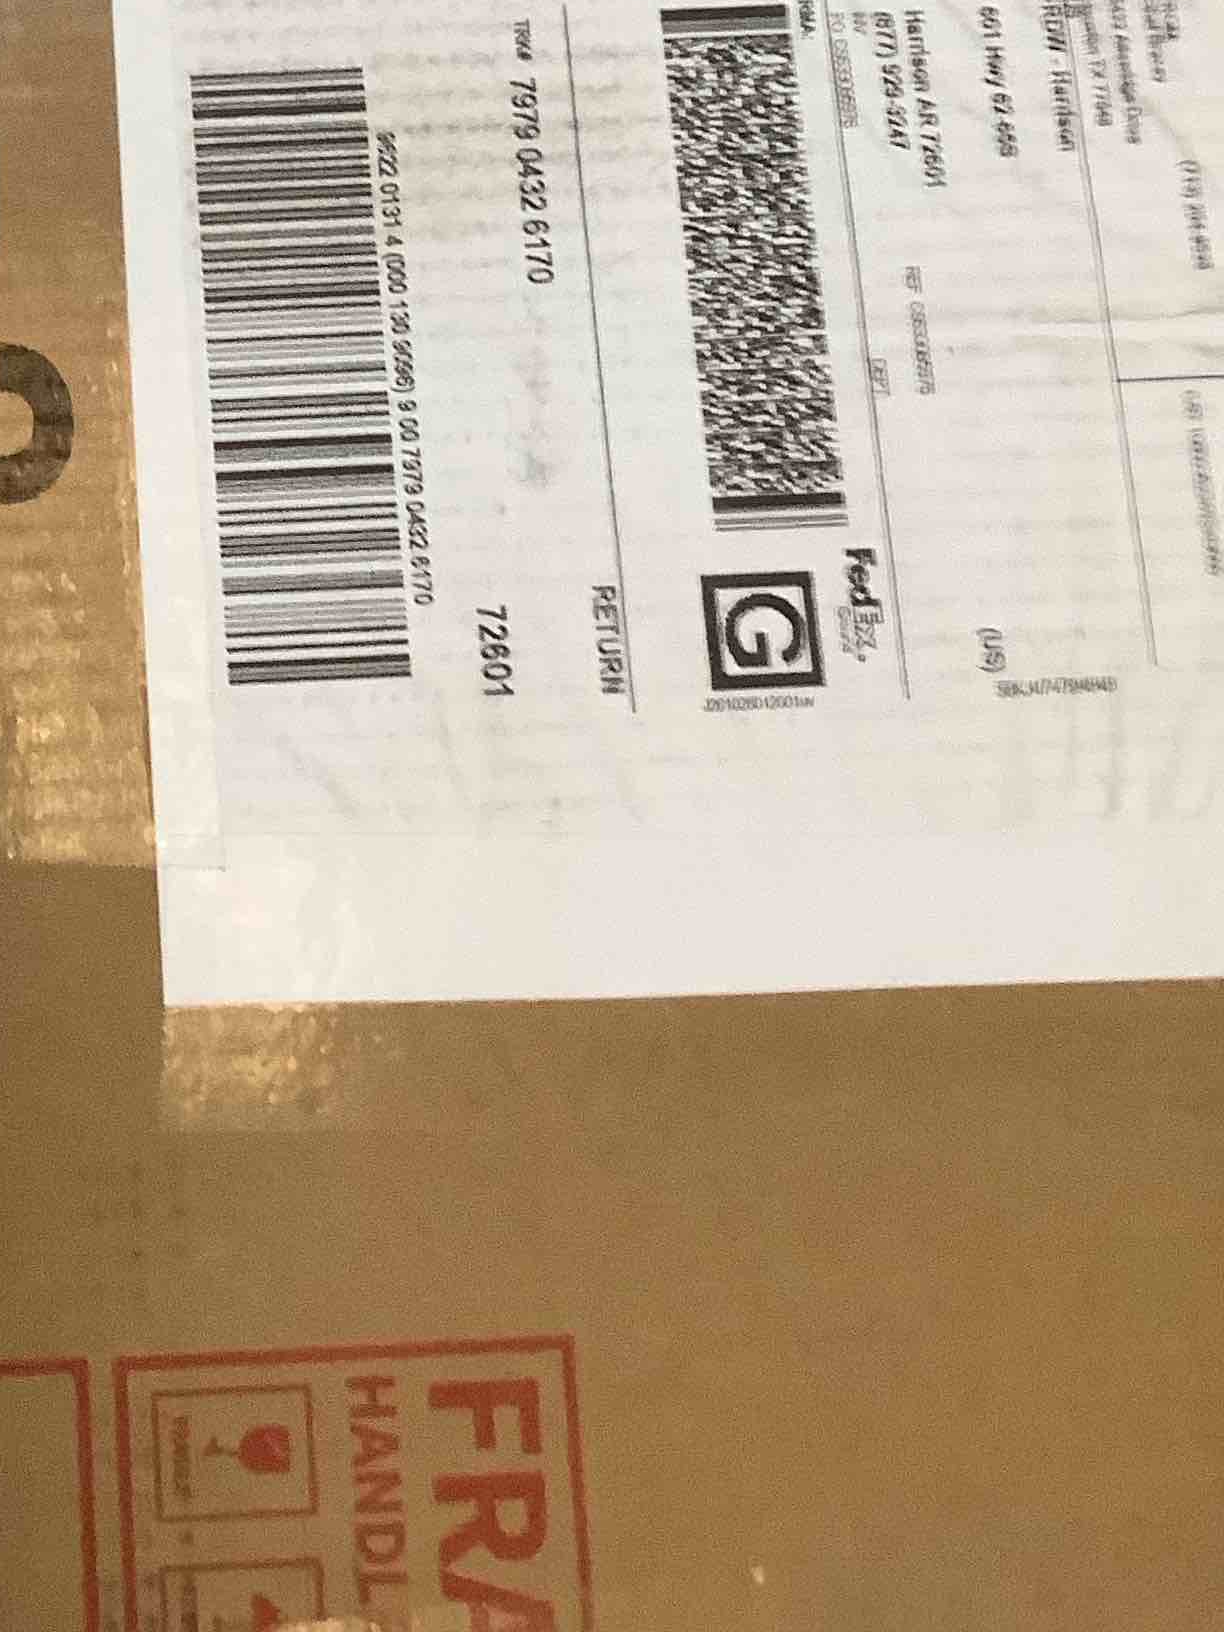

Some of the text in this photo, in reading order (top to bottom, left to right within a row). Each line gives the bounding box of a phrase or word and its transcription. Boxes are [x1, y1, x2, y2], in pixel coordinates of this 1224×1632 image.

[873, 11, 898, 58] (877)
[982, 46, 1007, 88] Hwy
[509, 77, 541, 141] 7979
[904, 9, 948, 188] Harrison AR 72601
[380, 182, 402, 228] 0131
[515, 147, 548, 213] 0432
[384, 233, 403, 247] 4
[522, 218, 555, 285] 6170
[397, 399, 418, 413] 9
[399, 417, 421, 443] 00
[401, 447, 425, 496] 7979
[405, 500, 429, 551] 0432
[476, 604, 515, 697] 72601
[592, 584, 626, 696] RETURN
[724, 592, 806, 668] G
[346, 1376, 408, 1618] HANDL
